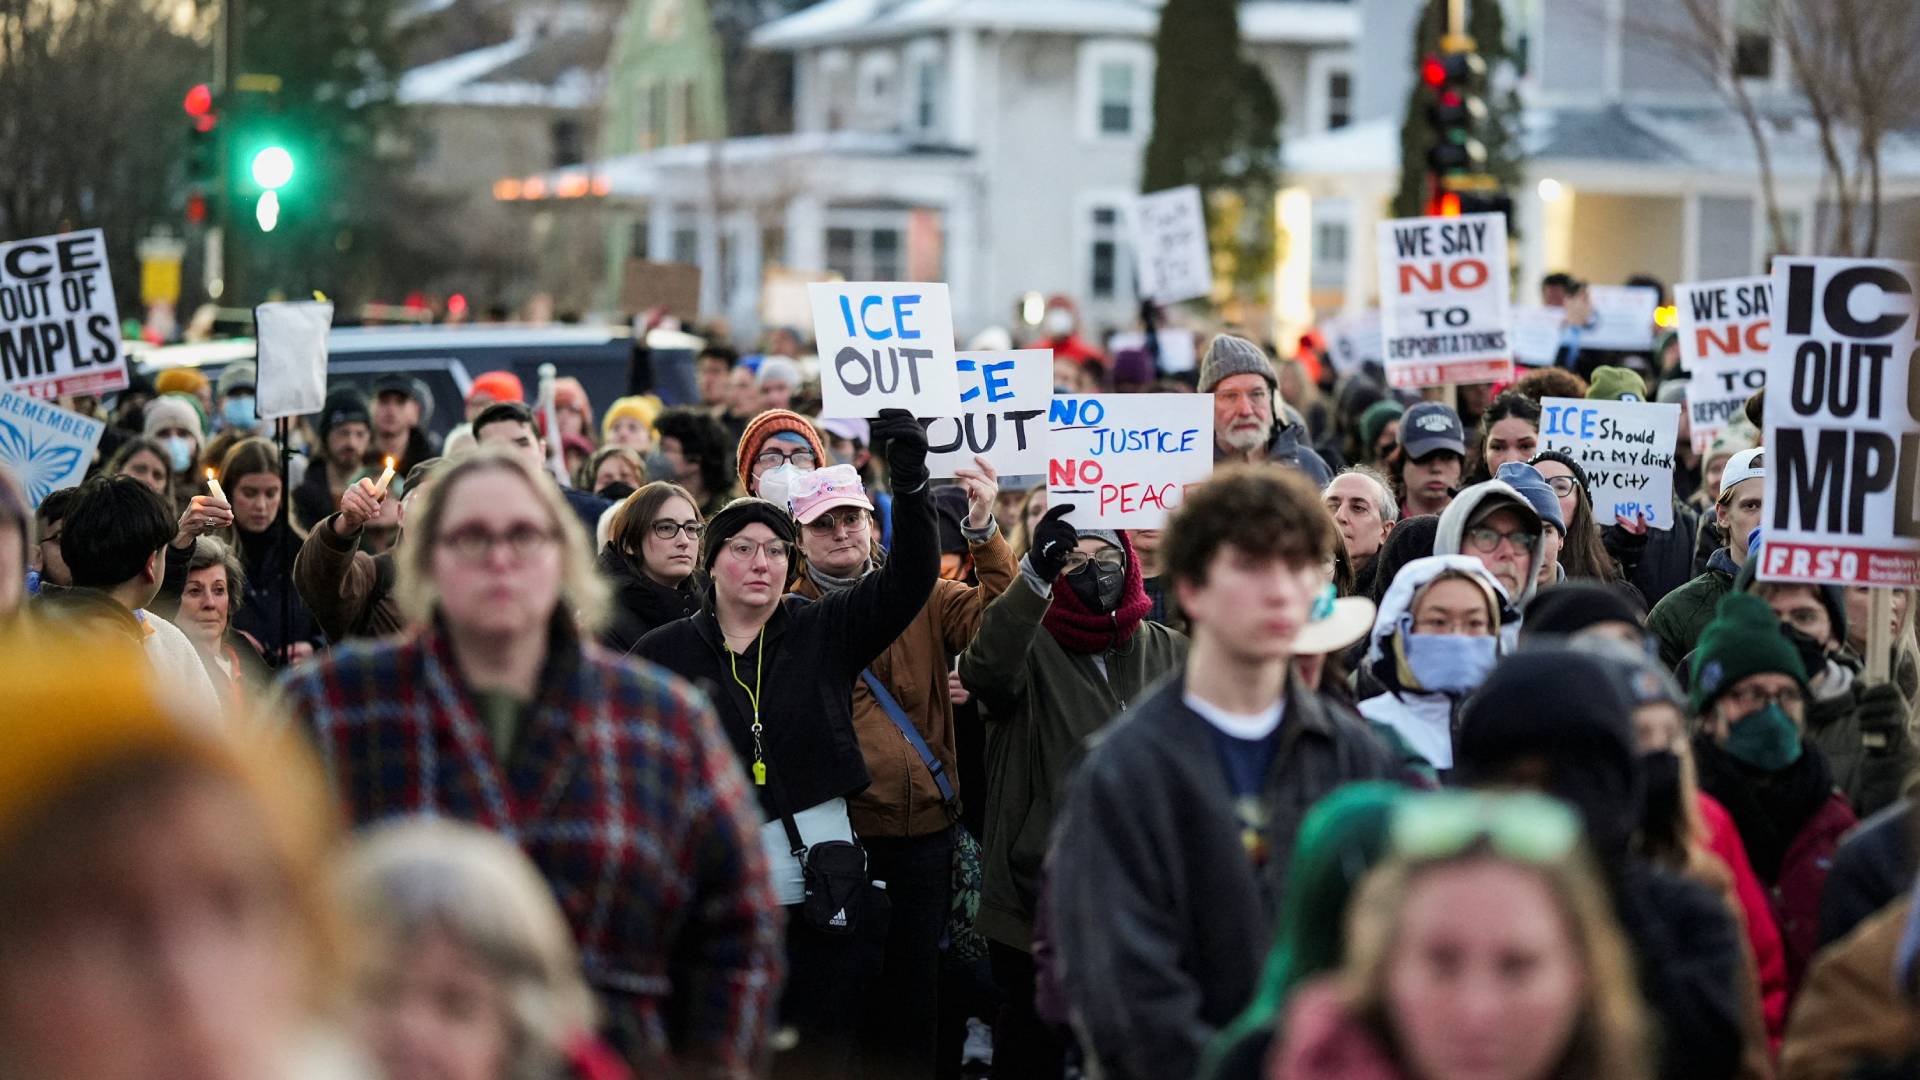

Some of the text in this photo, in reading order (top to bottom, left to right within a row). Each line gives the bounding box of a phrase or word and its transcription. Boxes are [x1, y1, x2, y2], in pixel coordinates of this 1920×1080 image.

[0, 237, 101, 279] CE
[1395, 223, 1486, 257] WE SAY
[1399, 260, 1489, 294] NO
[0, 275, 96, 320] OUT OF
[1691, 289, 1729, 321] WE
[1786, 265, 1920, 340] IC
[839, 295, 922, 340] ICE
[1418, 307, 1471, 328] TO
[0, 315, 116, 380] MPLS
[835, 347, 934, 396] OUT
[956, 360, 1015, 402] CE
[1717, 369, 1767, 391] TO
[1791, 341, 1893, 420] OUT
[1, 393, 96, 440] REMEMBER
[1049, 399, 1104, 425] NO
[1545, 406, 1599, 440] ICE
[1600, 418, 1655, 445] Should
[917, 410, 1046, 454] OUT
[1090, 428, 1199, 455] JUSTICE
[1049, 459, 1103, 486] NO
[1582, 444, 1605, 462] in
[1641, 450, 1672, 469] drink
[1100, 483, 1179, 516] PEAC
[1774, 428, 1920, 538] MPL
[1614, 503, 1655, 521] MPLS
